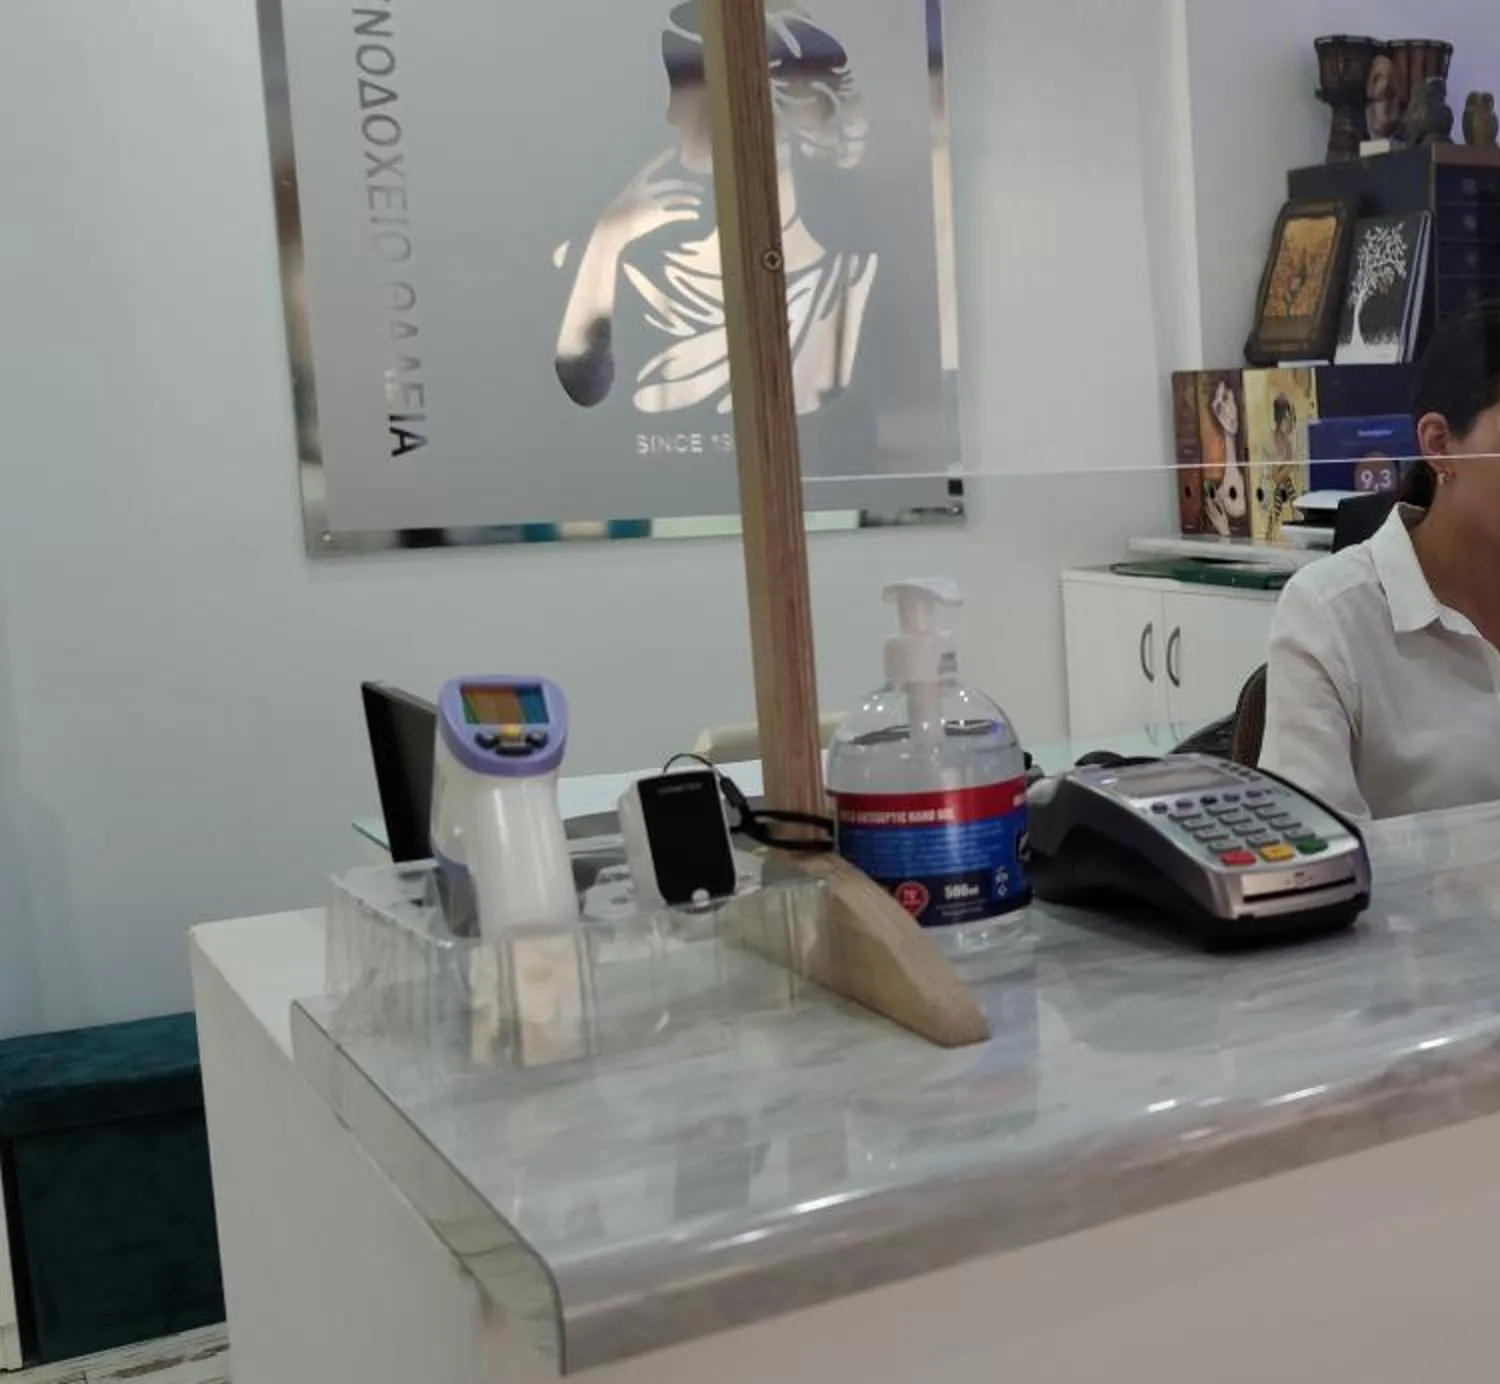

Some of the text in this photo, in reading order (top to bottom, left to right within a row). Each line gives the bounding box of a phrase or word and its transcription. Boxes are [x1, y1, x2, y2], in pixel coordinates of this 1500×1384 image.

[351, 0, 412, 263] ΝΟΔΟΧΕΙΟ
[637, 433, 733, 453] SINCE 19
